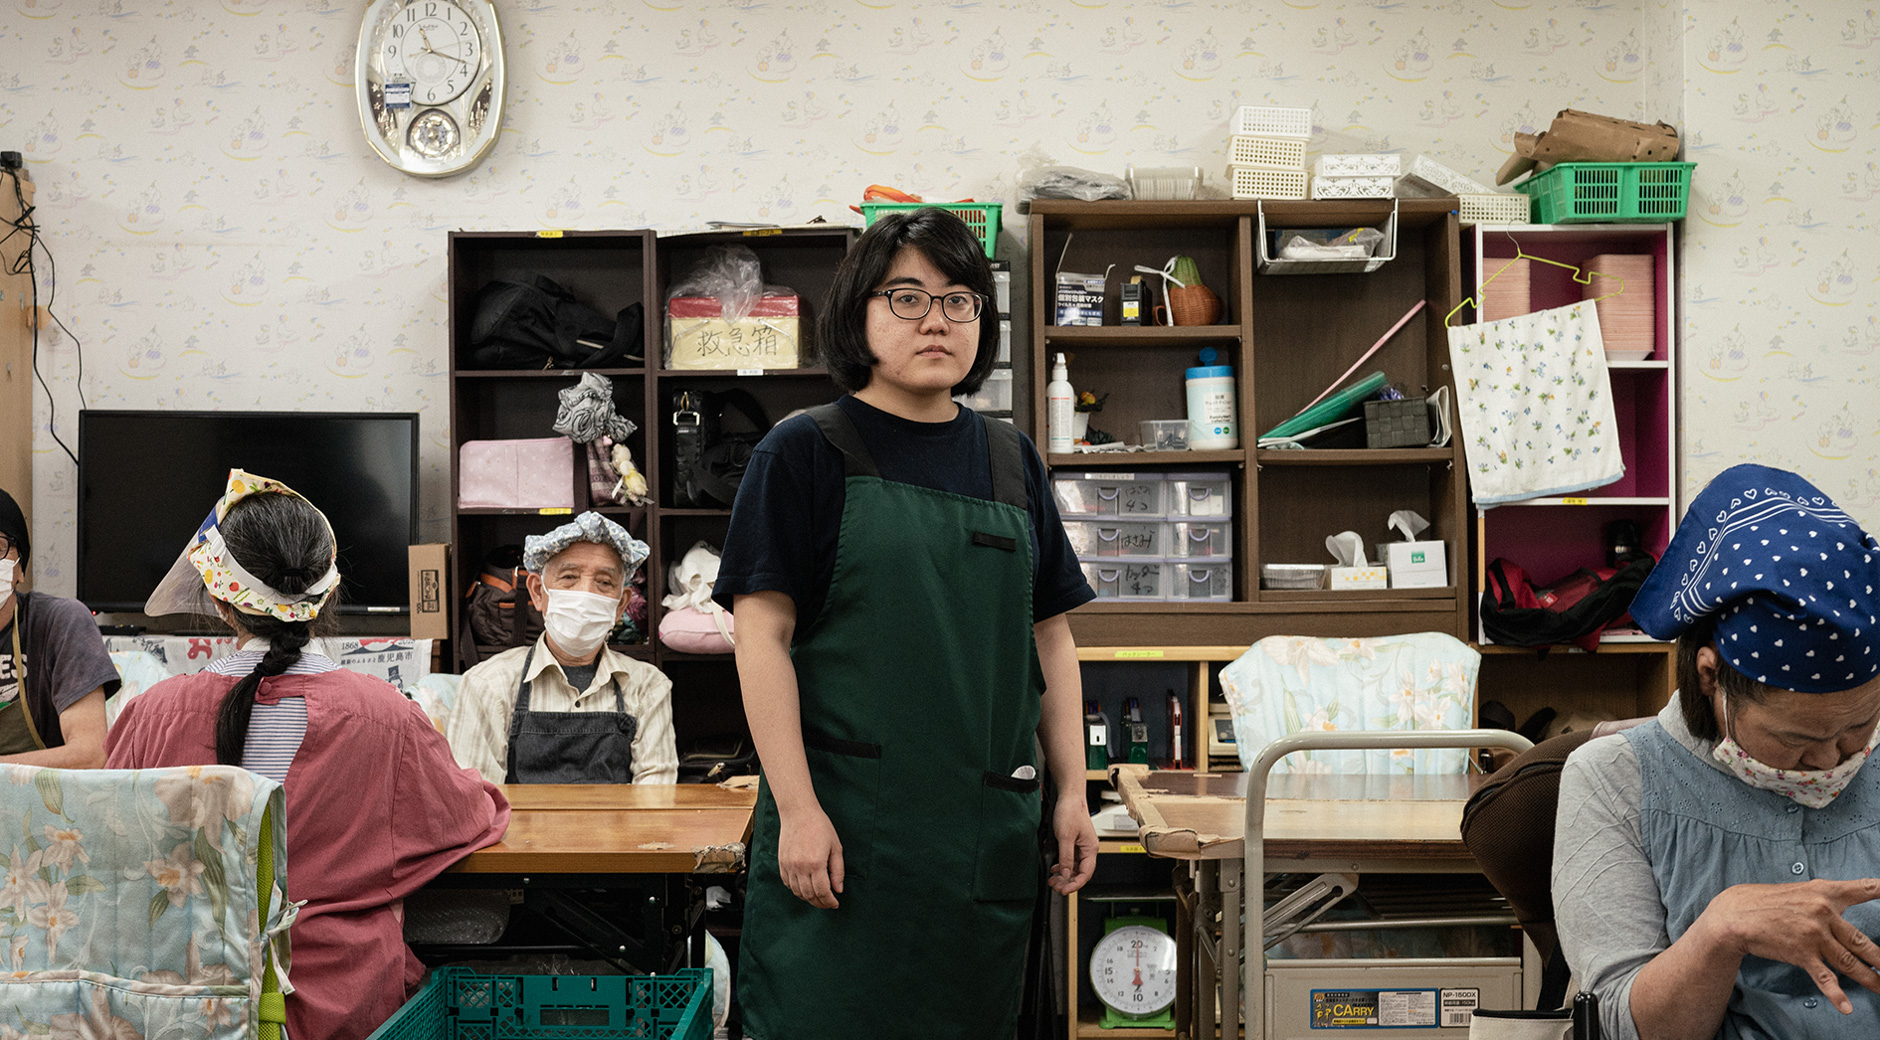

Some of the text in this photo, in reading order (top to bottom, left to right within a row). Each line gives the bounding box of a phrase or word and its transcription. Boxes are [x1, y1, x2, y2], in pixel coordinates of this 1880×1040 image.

[406, 8, 416, 22] 11
[425, 2, 437, 17] 12
[392, 24, 404, 38] 10
[459, 21, 468, 36] 2
[388, 45, 397, 60] 9
[465, 42, 474, 57] 3
[459, 64, 468, 77] 4
[410, 81, 417, 96] 7
[446, 80, 455, 94] 5
[427, 87, 436, 103] 6
[696, 326, 777, 357] 救急箱
[341, 641, 359, 650] 1868
[1131, 940, 1143, 949] 20
[1105, 967, 1113, 975] 15
[1133, 993, 1144, 1002] 10
